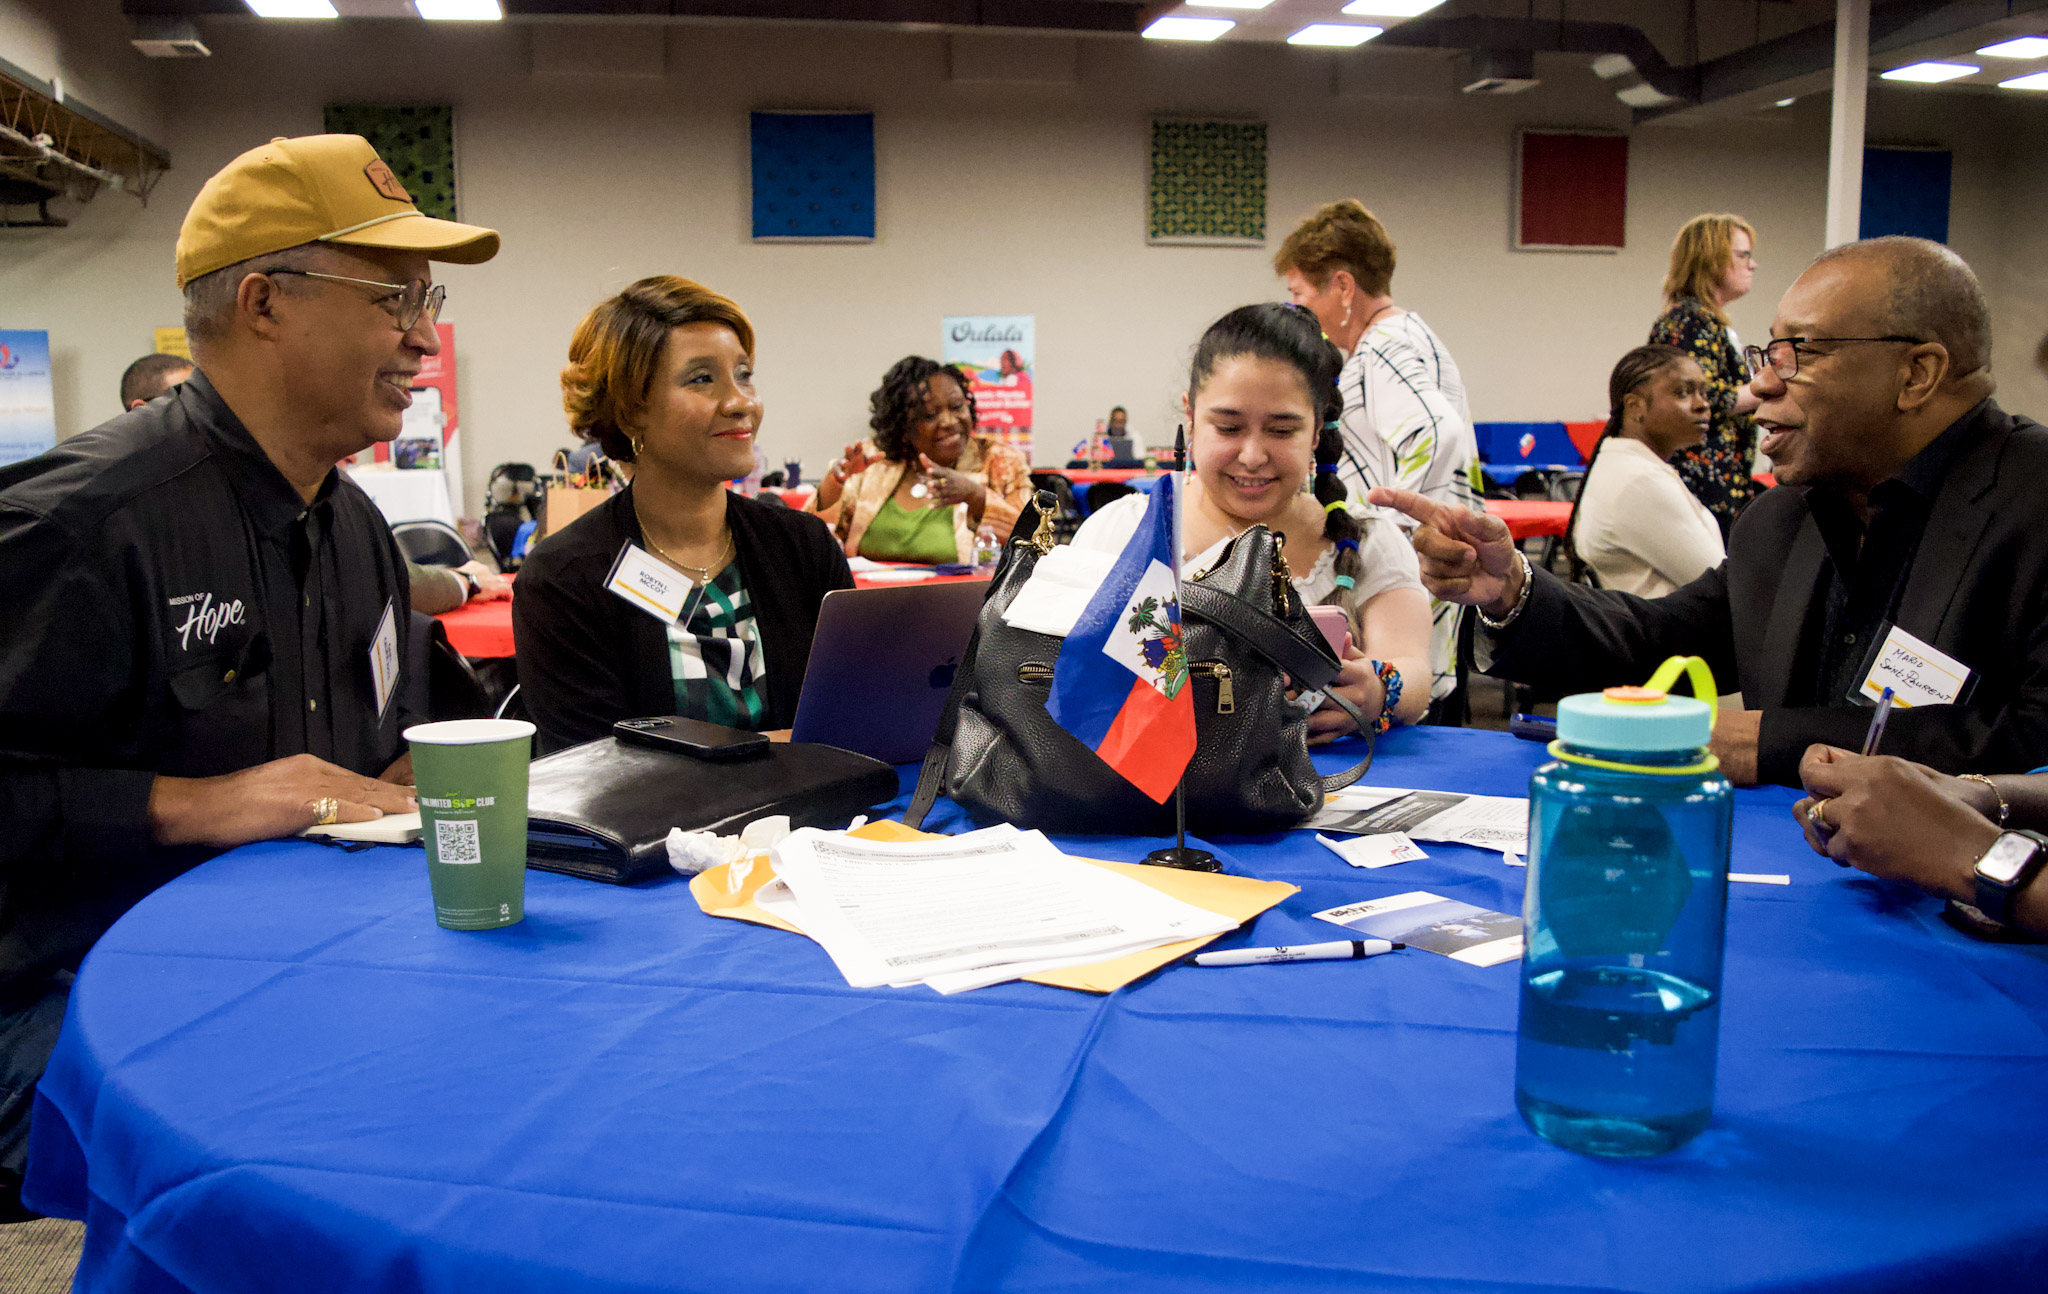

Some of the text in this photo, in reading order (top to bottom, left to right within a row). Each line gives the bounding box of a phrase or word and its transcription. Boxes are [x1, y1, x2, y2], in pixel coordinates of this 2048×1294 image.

[951, 321, 1023, 342] Oulala
[640, 571, 664, 589] ROBYN
[640, 578, 666, 595] MCCOY
[169, 593, 205, 605] MISSION OF
[175, 592, 245, 651] Hope
[1892, 649, 1924, 668] MARIO
[421, 796, 452, 808] UNLIMITED
[476, 796, 495, 807] CLUB
